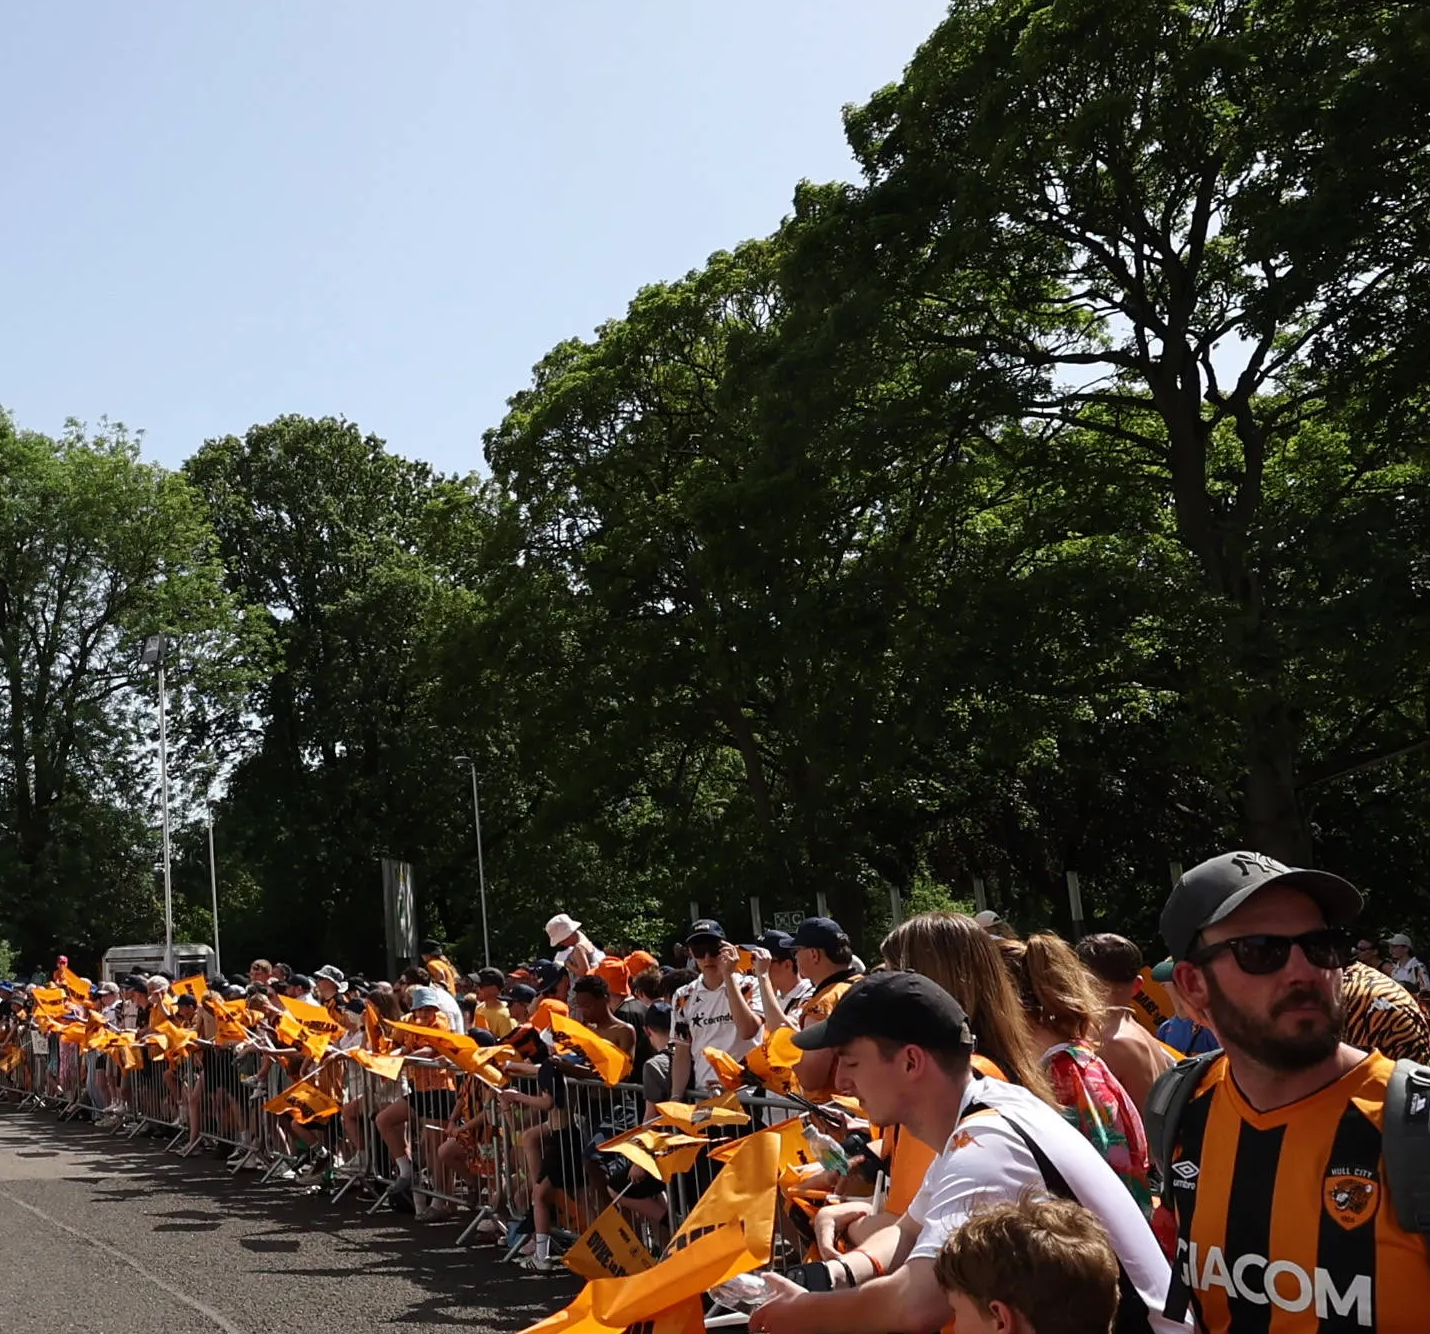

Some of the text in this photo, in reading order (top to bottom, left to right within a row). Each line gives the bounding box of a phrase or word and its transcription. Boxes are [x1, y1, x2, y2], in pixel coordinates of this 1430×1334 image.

[1331, 1167, 1372, 1178] HULL CITY
[1173, 1179, 1196, 1190] umbro
